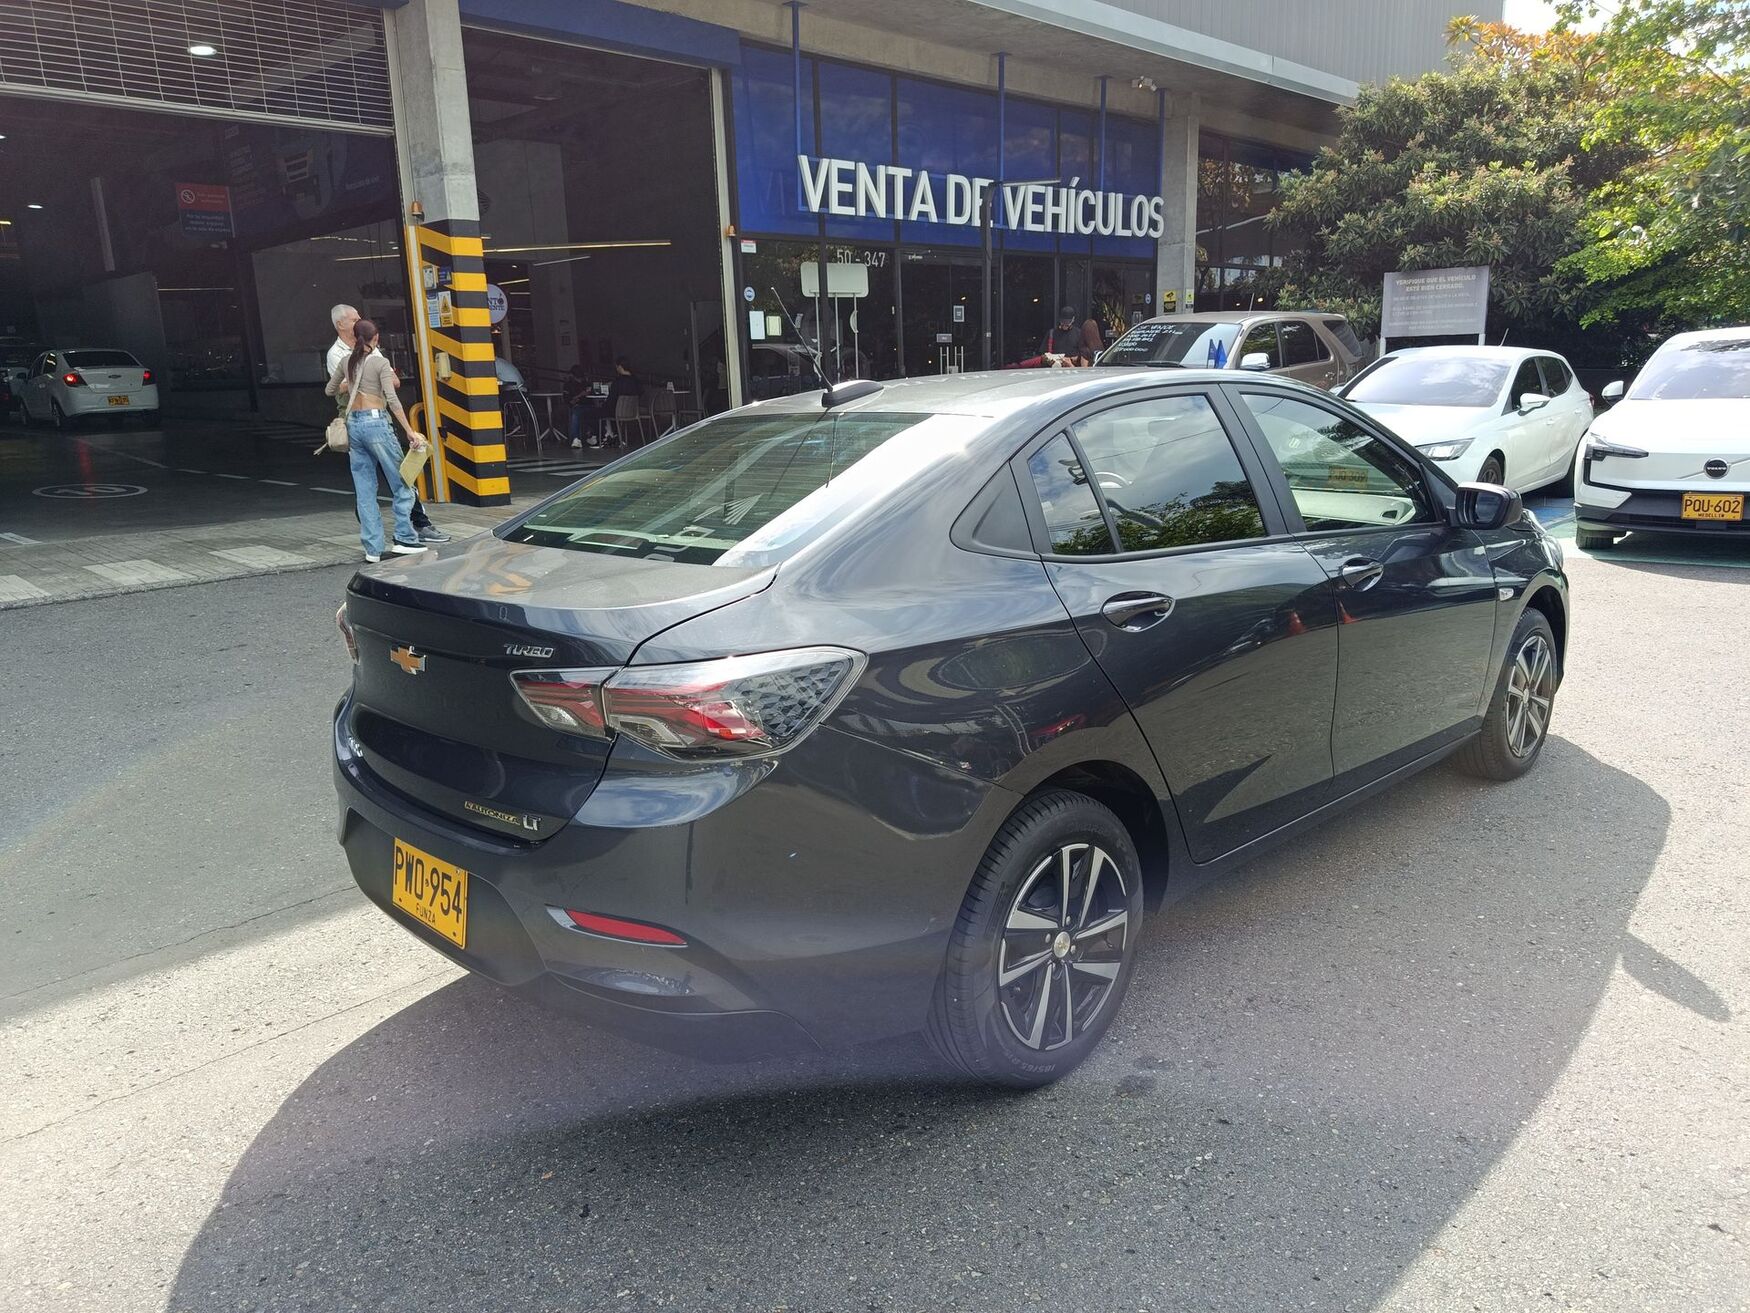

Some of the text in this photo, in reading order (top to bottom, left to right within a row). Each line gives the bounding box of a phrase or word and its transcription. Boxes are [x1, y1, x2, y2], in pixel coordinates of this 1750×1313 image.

[798, 155, 938, 223] VENTA
[1003, 177, 1165, 239] VEHÍCULOS
[864, 251, 886, 268] 347
[504, 644, 554, 658] TURBO
[416, 902, 436, 925] FUNZA
